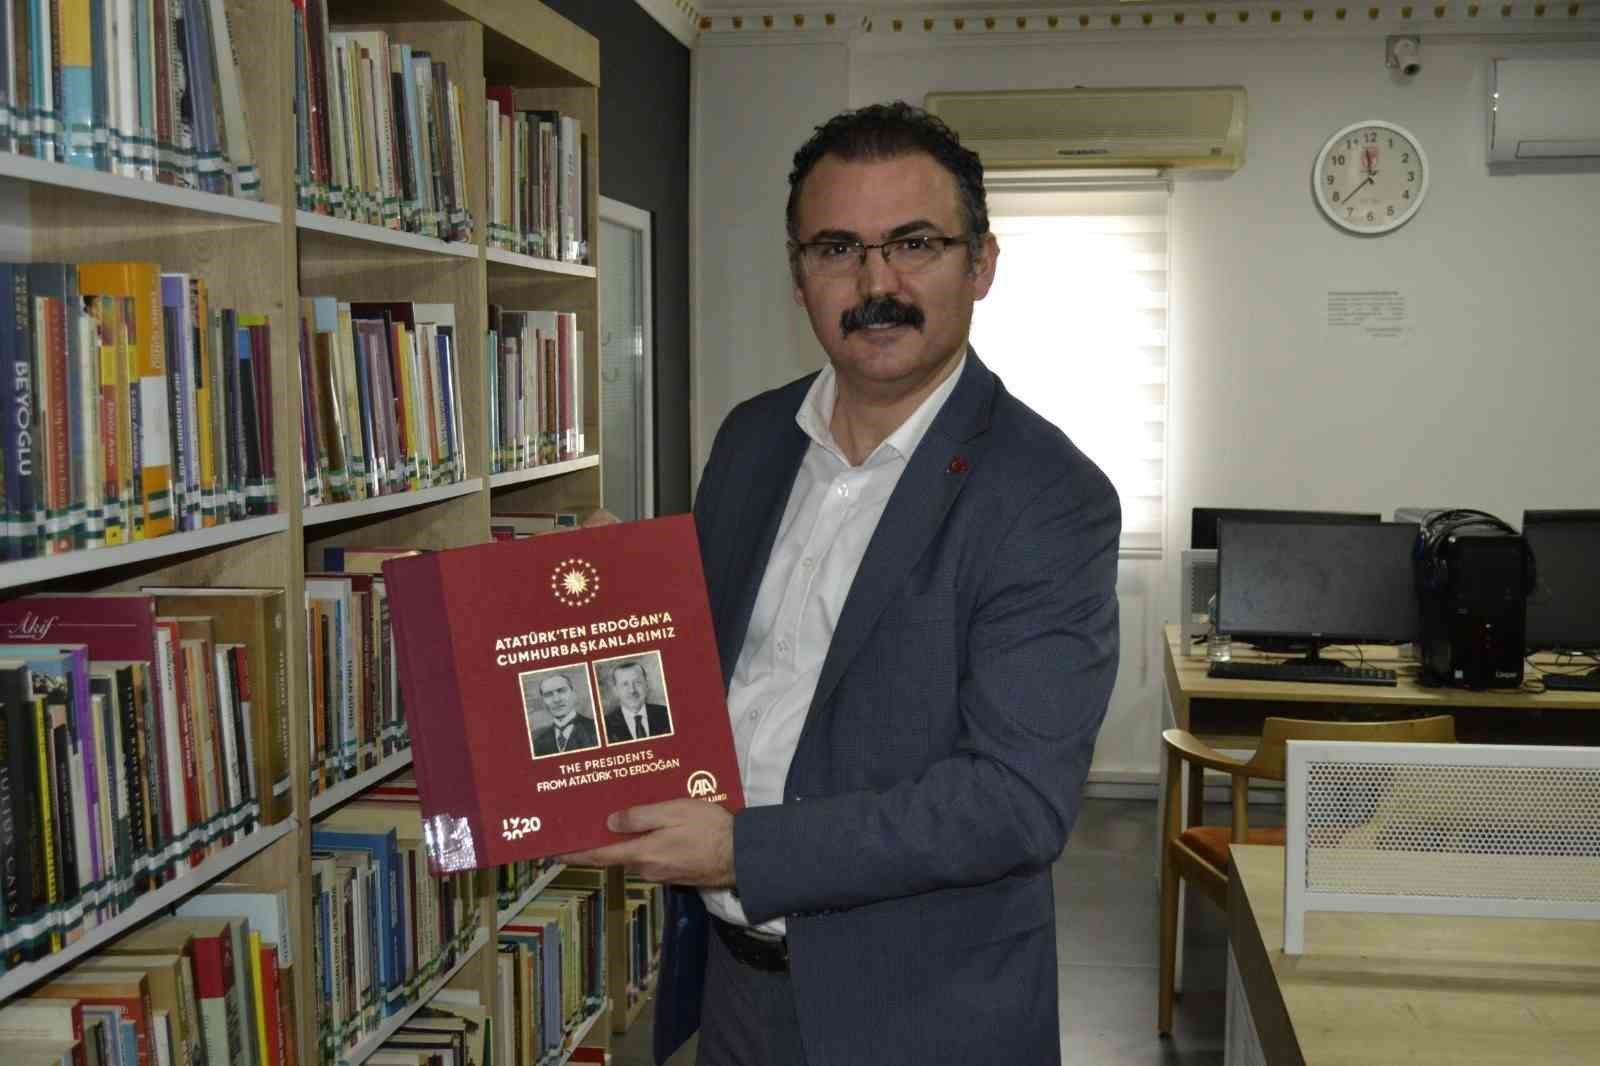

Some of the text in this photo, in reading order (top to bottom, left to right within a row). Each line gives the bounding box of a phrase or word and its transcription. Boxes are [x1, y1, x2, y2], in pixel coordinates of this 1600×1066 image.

[1364, 133, 1377, 143] 12
[1331, 155, 1345, 166] 10
[1401, 153, 1409, 163] 2
[1327, 175, 1335, 185] 9
[1408, 171, 1415, 182] 3
[1332, 191, 1340, 202] 8
[1401, 189, 1409, 199] 4
[1346, 207, 1354, 217] 7
[1366, 211, 1374, 222] 6
[1386, 206, 1394, 217] 5
[495, 612, 673, 651] ATATÜRK'TEN ERDOĞAN'A
[496, 627, 676, 666] CUMHURBAŞKANLARIMIZ
[559, 750, 655, 775] THE PRESIDENTS
[536, 758, 681, 793] FROM ATATÜRK TO ERDOĞAN
